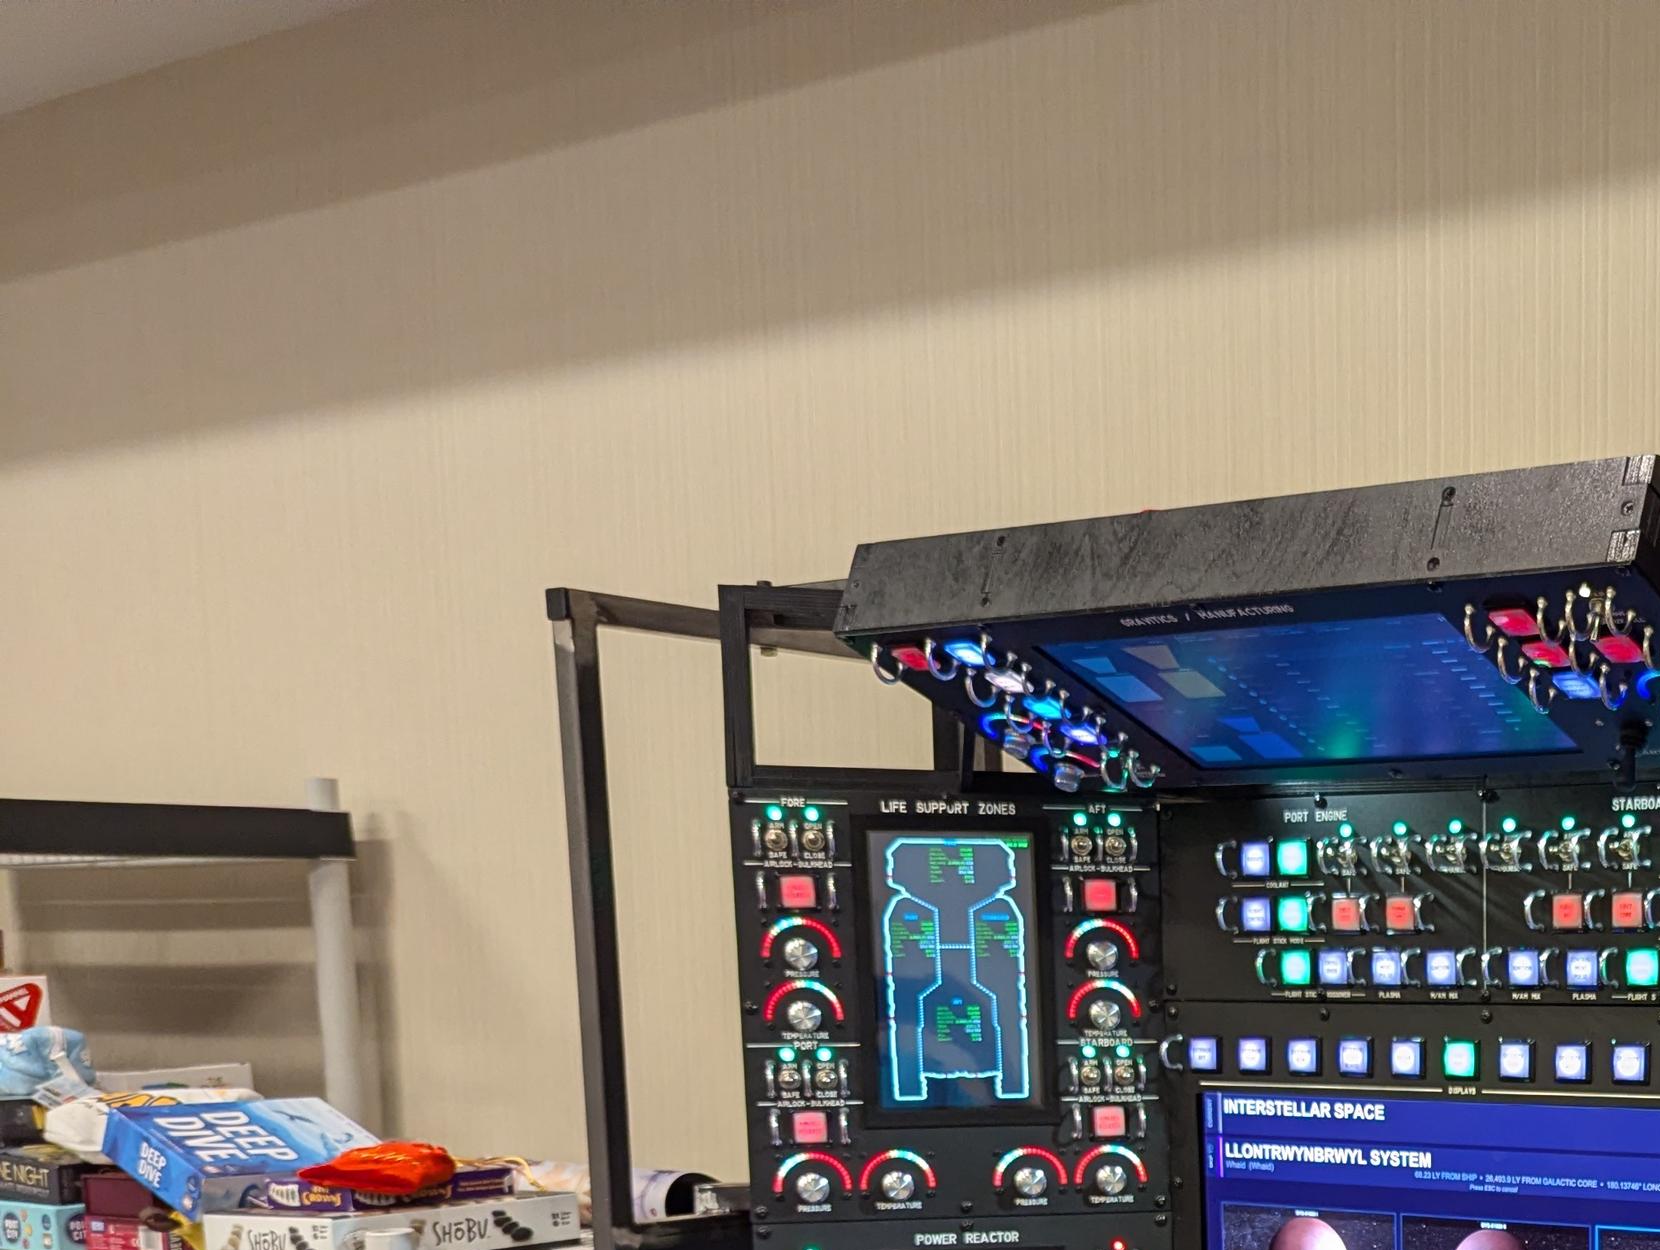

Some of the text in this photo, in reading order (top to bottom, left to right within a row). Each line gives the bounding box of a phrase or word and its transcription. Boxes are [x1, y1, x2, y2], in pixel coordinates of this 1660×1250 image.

[1120, 615, 1178, 627] GRAVITICS
[1197, 604, 1294, 620] MANUFACTURING
[780, 798, 806, 808] FORE
[881, 801, 1016, 816] LIFE SUPPORT ZONES
[1088, 805, 1107, 813] AFT
[1284, 809, 1347, 823] PORT ENGINE
[1266, 881, 1289, 889] COOLANT
[785, 970, 819, 978] PRESSURE
[1088, 970, 1118, 978] PRESSURE
[782, 1032, 829, 1040] TEMPERATURE
[1084, 1029, 1127, 1037] TEMPERATURE
[793, 1041, 818, 1050] PORT
[1080, 1038, 1133, 1047] STARBOARD
[1449, 1087, 1476, 1095] DISPLAYS
[1223, 1099, 1331, 1118] INTERSTELLAR
[1333, 1103, 1385, 1120] SPACE
[153, 1116, 250, 1162] DIVE
[201, 1111, 299, 1161] DEEP
[141, 1142, 167, 1168] DEEP
[1225, 1143, 1367, 1166] LLONTRWYNBRWYL
[1370, 1149, 1431, 1169] SYSTEM
[13, 1163, 50, 1188] NIGHT
[139, 1159, 162, 1188] DIVE
[1432, 1172, 1440, 1180] LY
[1441, 1172, 1461, 1181] FROM
[1512, 1176, 1521, 1184] LY
[1522, 1176, 1542, 1185] FROM
[1543, 1177, 1576, 1187] GALACTIC
[1577, 1179, 1597, 1188] CORE
[1016, 1197, 1048, 1205] PRESSURE
[1090, 1195, 1133, 1205] TEMPERATURE
[798, 1203, 831, 1212] PRESSURE
[876, 1201, 922, 1210] TEMPERATURE
[915, 1231, 1019, 1246] POWER REACTOR
